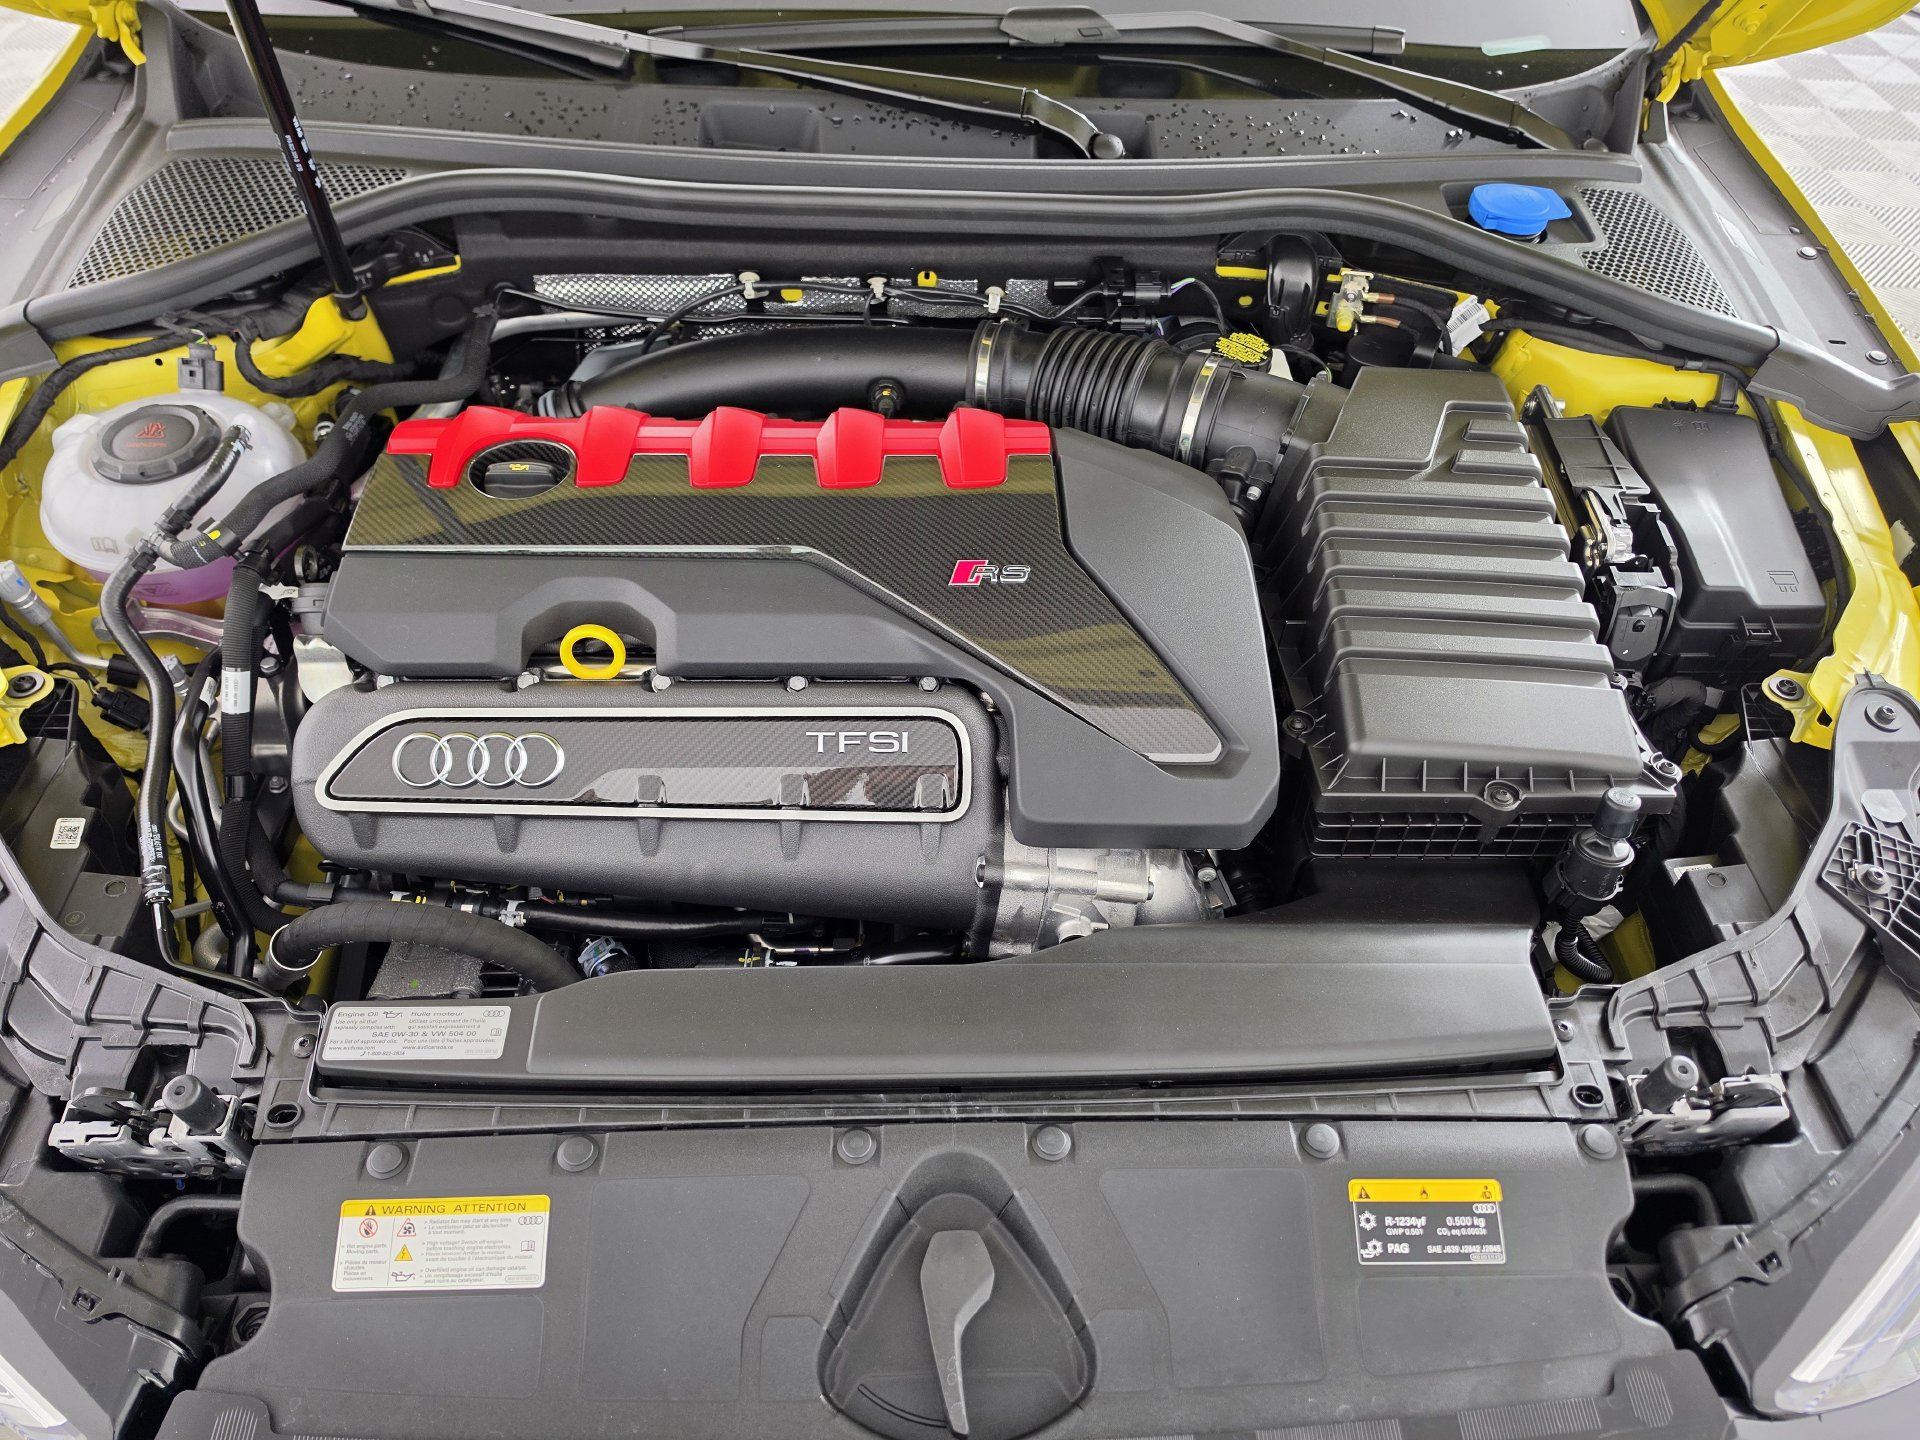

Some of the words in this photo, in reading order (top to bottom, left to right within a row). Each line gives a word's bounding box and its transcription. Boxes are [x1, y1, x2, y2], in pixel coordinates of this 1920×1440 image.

[967, 564, 1031, 583] RS
[805, 731, 908, 753] TFSI
[382, 1204, 446, 1214] WARNING
[453, 1203, 527, 1212] ATTENTION
[1385, 1216, 1426, 1228] R-1234yf
[1446, 1217, 1472, 1226] 0.500
[1474, 1216, 1486, 1227] kg
[1387, 1243, 1410, 1253] PAG
[1427, 1245, 1442, 1253] SAE
